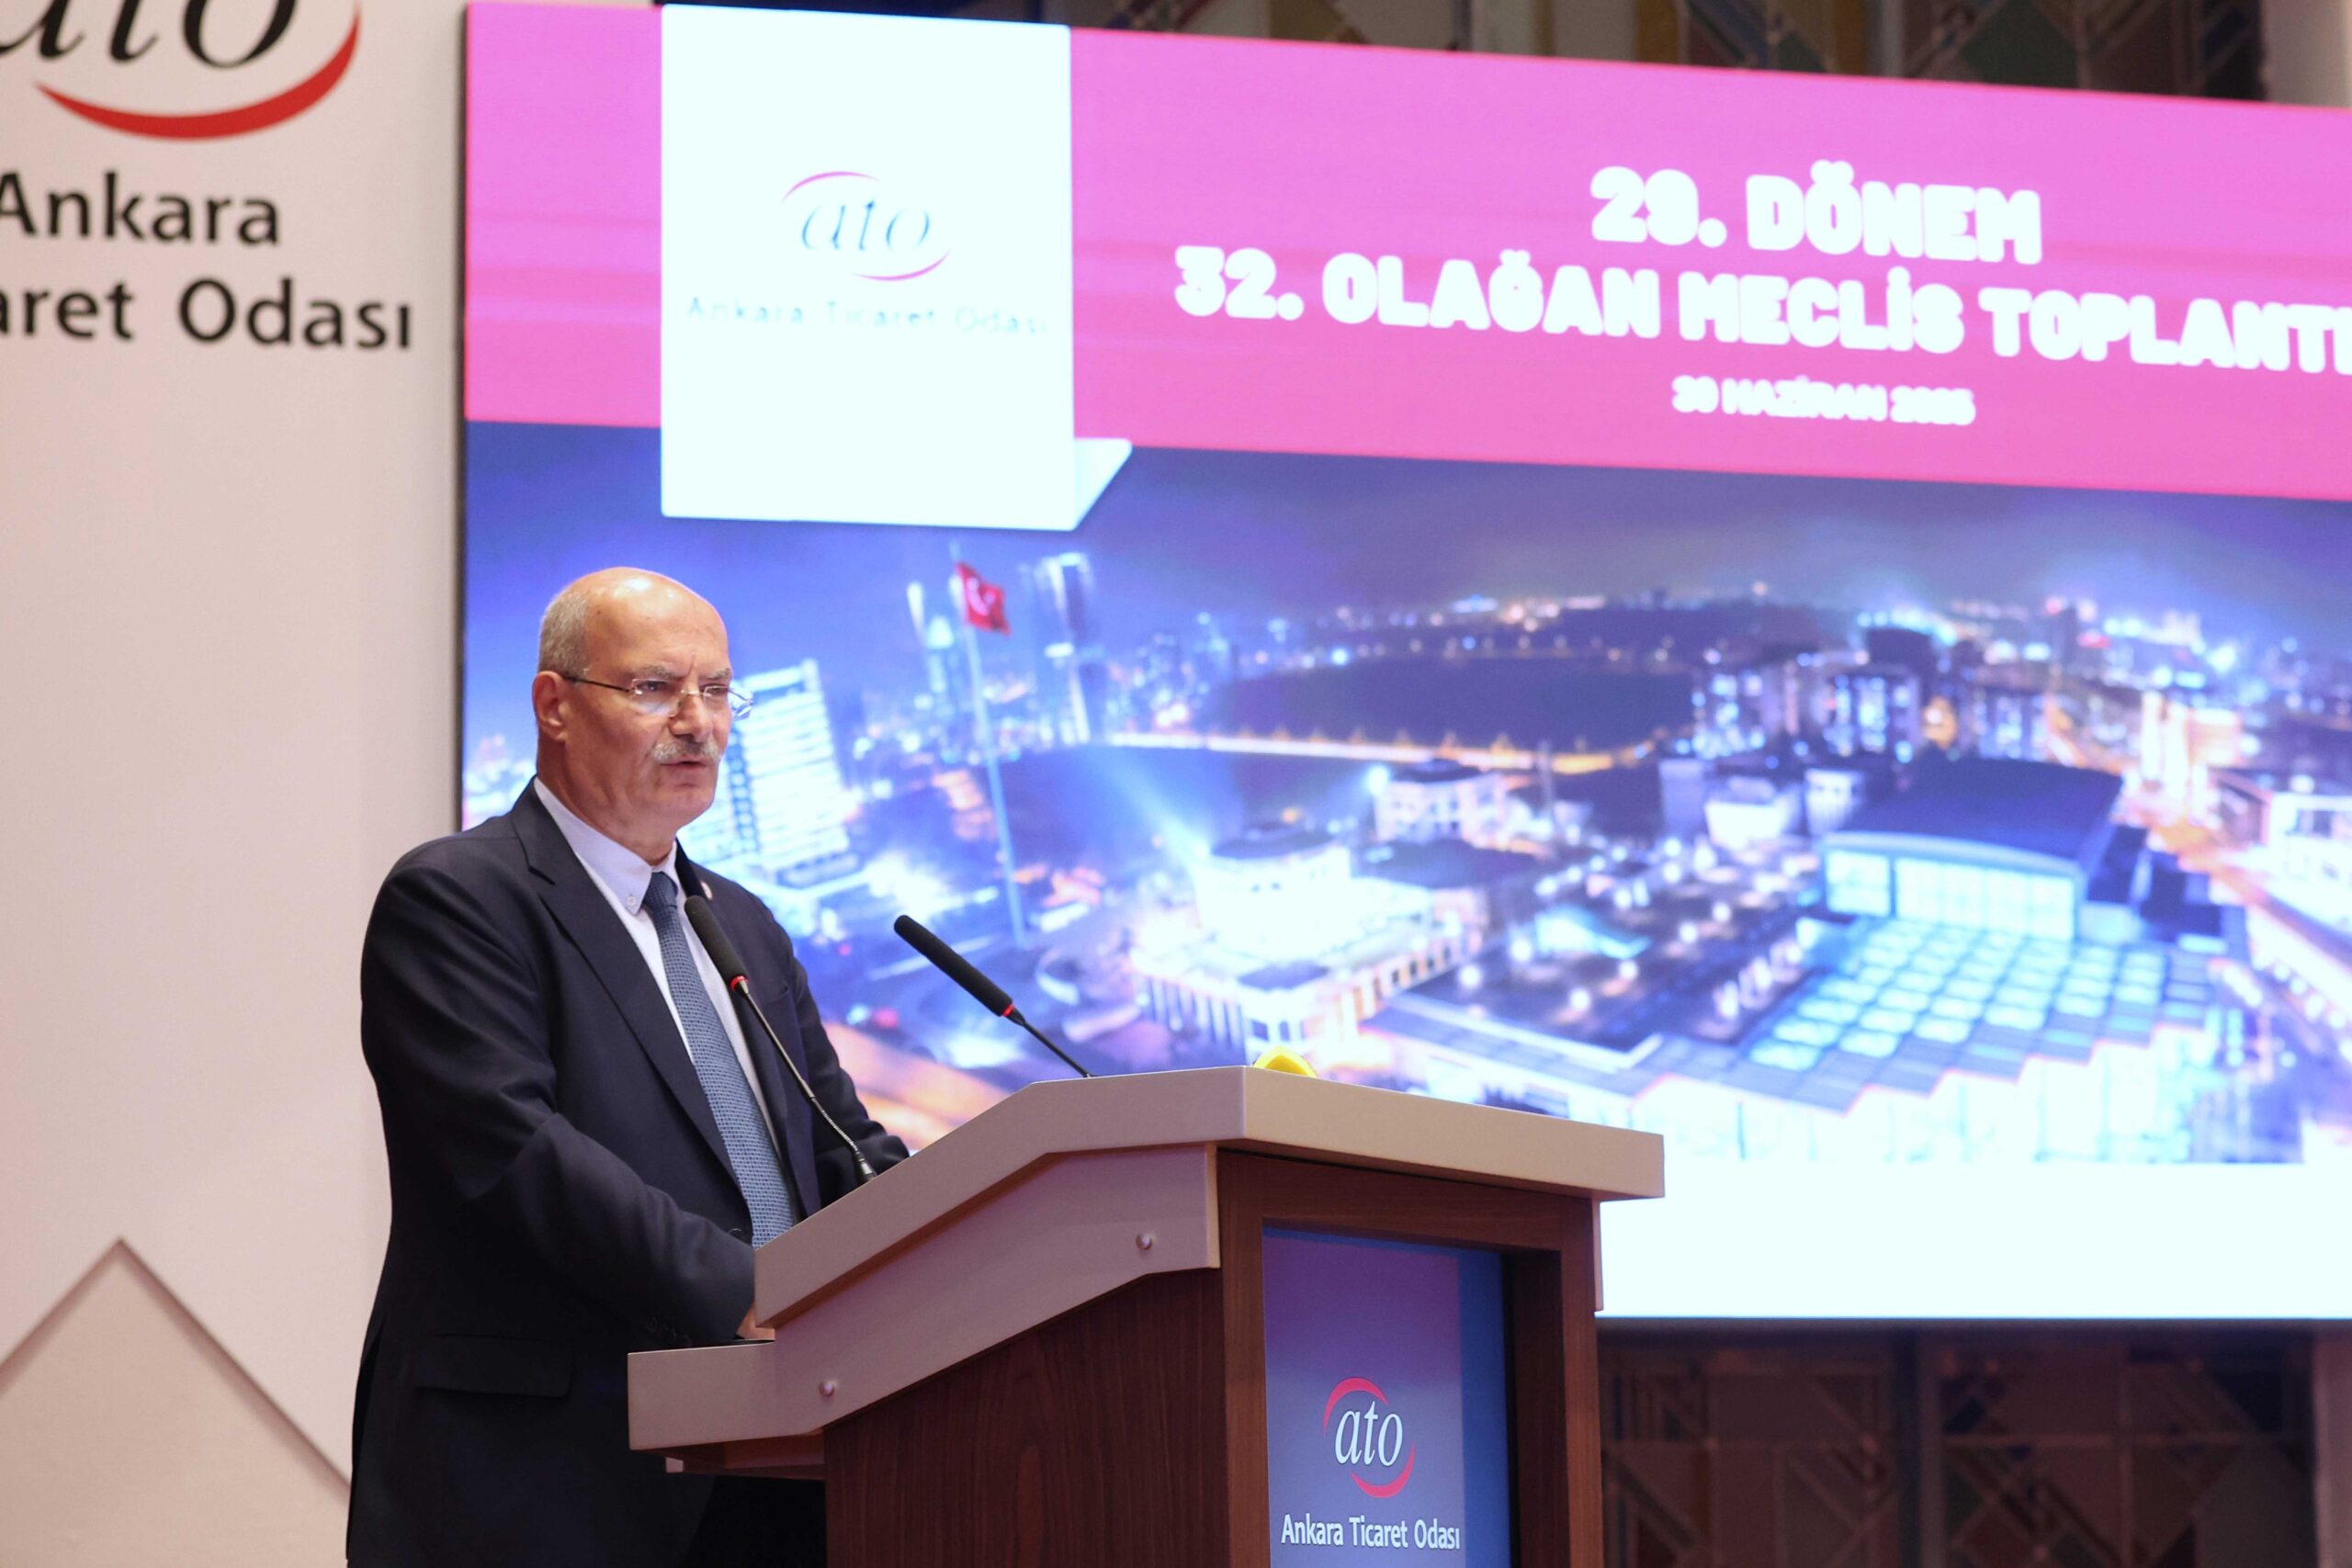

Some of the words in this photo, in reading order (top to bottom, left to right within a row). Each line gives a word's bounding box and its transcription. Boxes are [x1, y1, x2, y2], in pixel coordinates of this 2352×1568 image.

[0, 171, 280, 246] Ankara
[1746, 159, 2042, 265] DÖNEM
[178, 276, 413, 350] Odası
[1174, 245, 1304, 321] 32.
[1321, 248, 1661, 338] OLAĞAN
[1678, 265, 1965, 355] MECLİS
[1334, 1400, 1404, 1467] ato
[1281, 1513, 1345, 1546] Ankara
[1348, 1515, 1409, 1549] Ticaret
[1413, 1517, 1461, 1550] Odası
